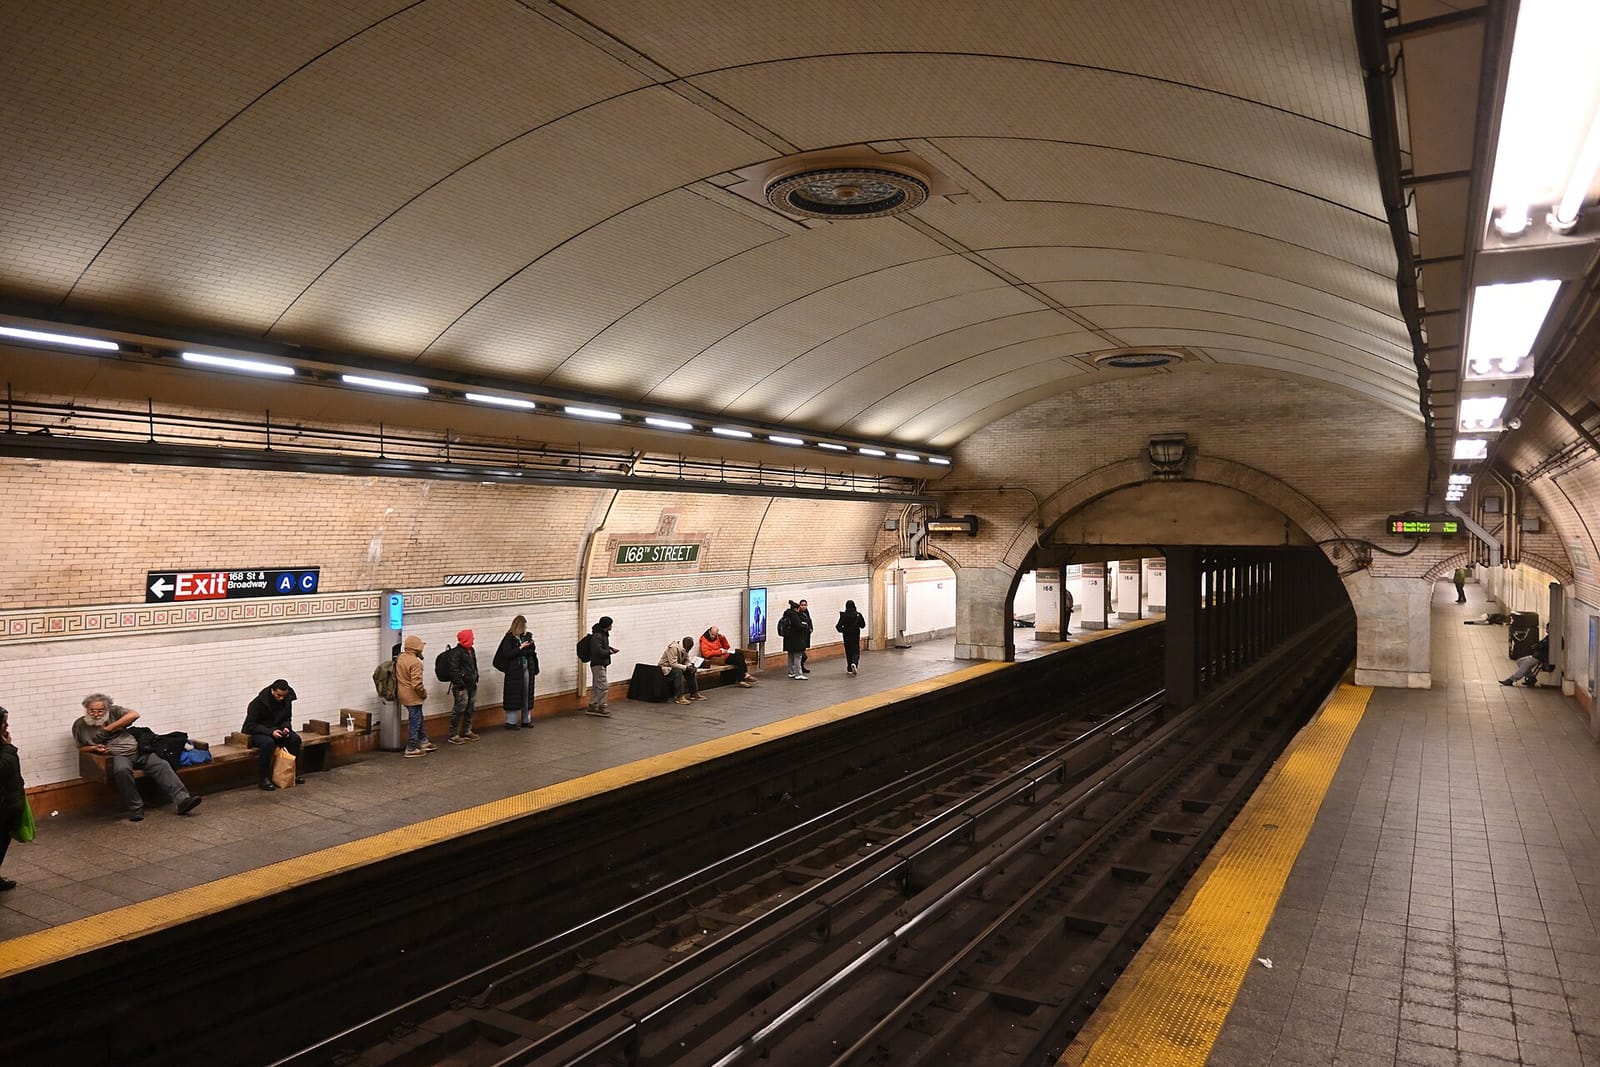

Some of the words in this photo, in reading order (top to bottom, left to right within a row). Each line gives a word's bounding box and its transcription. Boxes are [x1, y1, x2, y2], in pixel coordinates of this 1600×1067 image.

[651, 546, 693, 561] STREET
[229, 572, 244, 581] 168
[246, 572, 256, 580] St
[258, 572, 265, 580] &
[280, 576, 291, 589] A
[302, 576, 313, 588] C
[175, 573, 227, 596] Exit
[227, 580, 268, 589] Broadway
